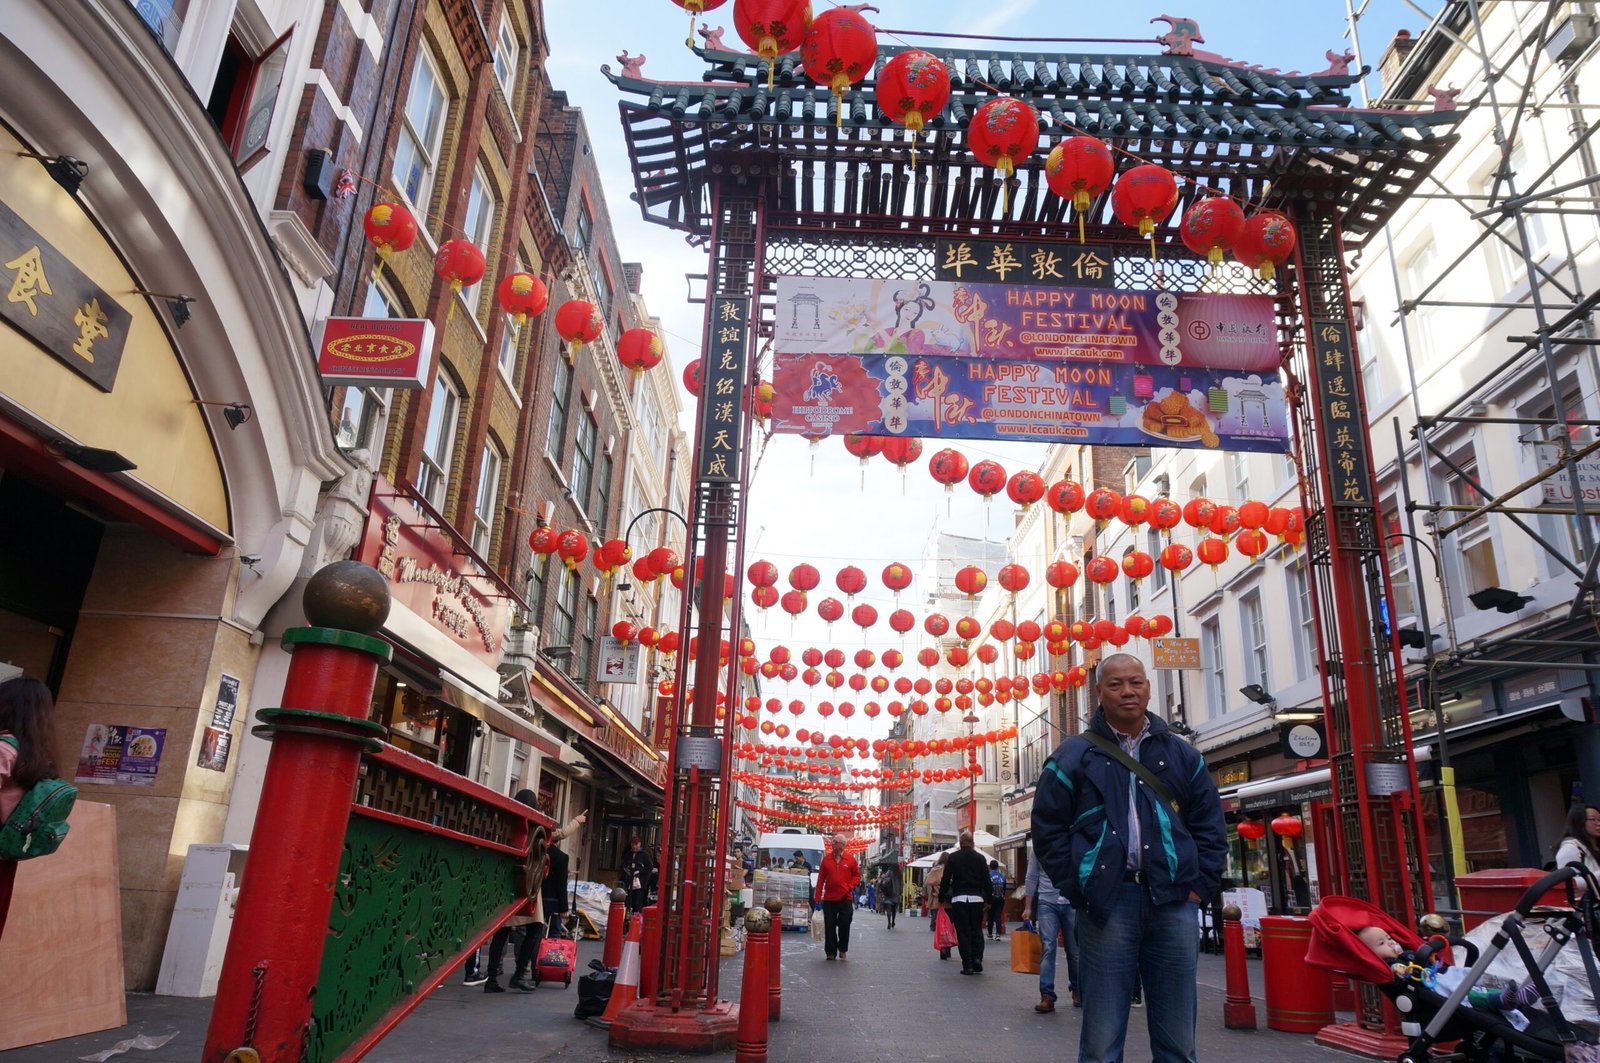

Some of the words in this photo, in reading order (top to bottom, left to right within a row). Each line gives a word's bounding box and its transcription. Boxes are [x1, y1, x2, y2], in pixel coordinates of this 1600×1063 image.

[1007, 290, 1075, 309] HAPPY
[1091, 293, 1146, 311] MOON
[1022, 311, 1133, 330] FESTIVAL
[1020, 330, 1137, 345] @LONDONCHINATOWN
[1035, 347, 1123, 358] www.lccauk.com
[968, 363, 1039, 382] HAPPY
[1055, 367, 1111, 385] MOON
[984, 385, 1097, 406] FESTIVAL
[792, 406, 853, 414] HIPPODROME
[981, 408, 1101, 422] @LONDONCHINATOWN
[805, 414, 840, 422] CASINO
[997, 425, 1088, 436] www.lccauk.com
[1001, 717, 1010, 768] HAZHAN
